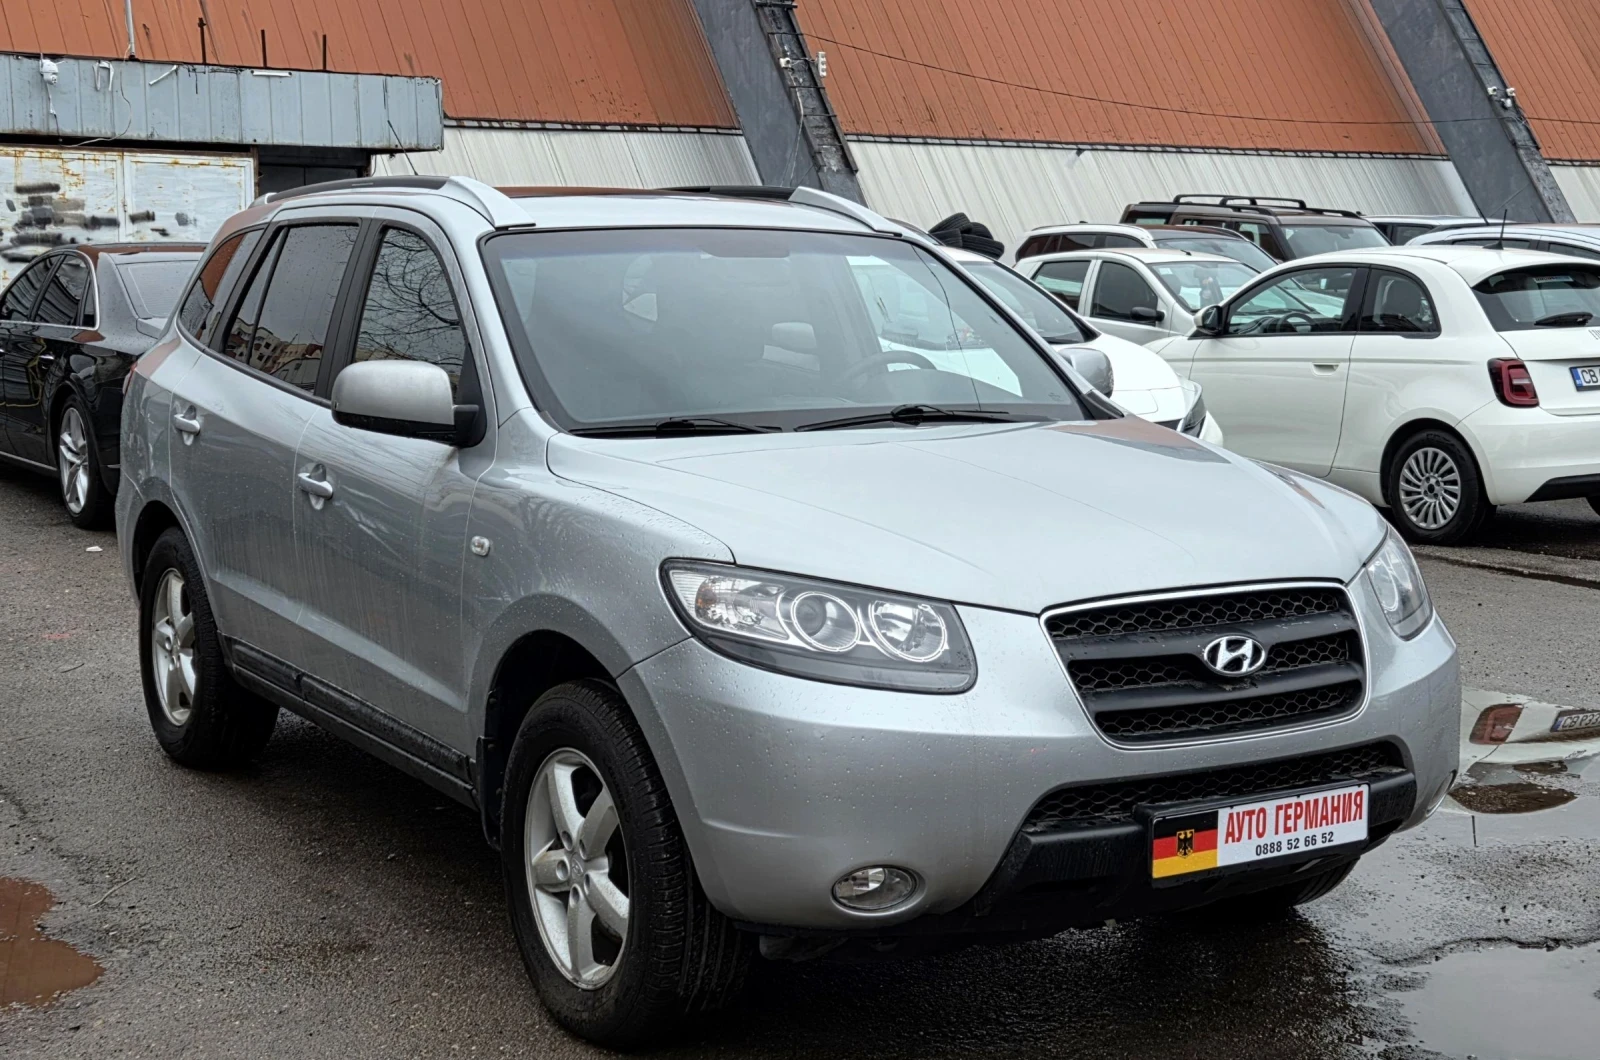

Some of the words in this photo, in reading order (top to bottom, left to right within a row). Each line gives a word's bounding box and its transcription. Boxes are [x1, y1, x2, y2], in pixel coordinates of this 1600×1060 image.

[1581, 369, 1598, 384] CB
[1225, 808, 1267, 844] АУТО
[1275, 791, 1364, 835] ГЕРМАНИЯ
[1255, 841, 1282, 856] 0888
[1286, 838, 1300, 850] 52
[1304, 835, 1317, 847] 66
[1321, 832, 1334, 844] 52
